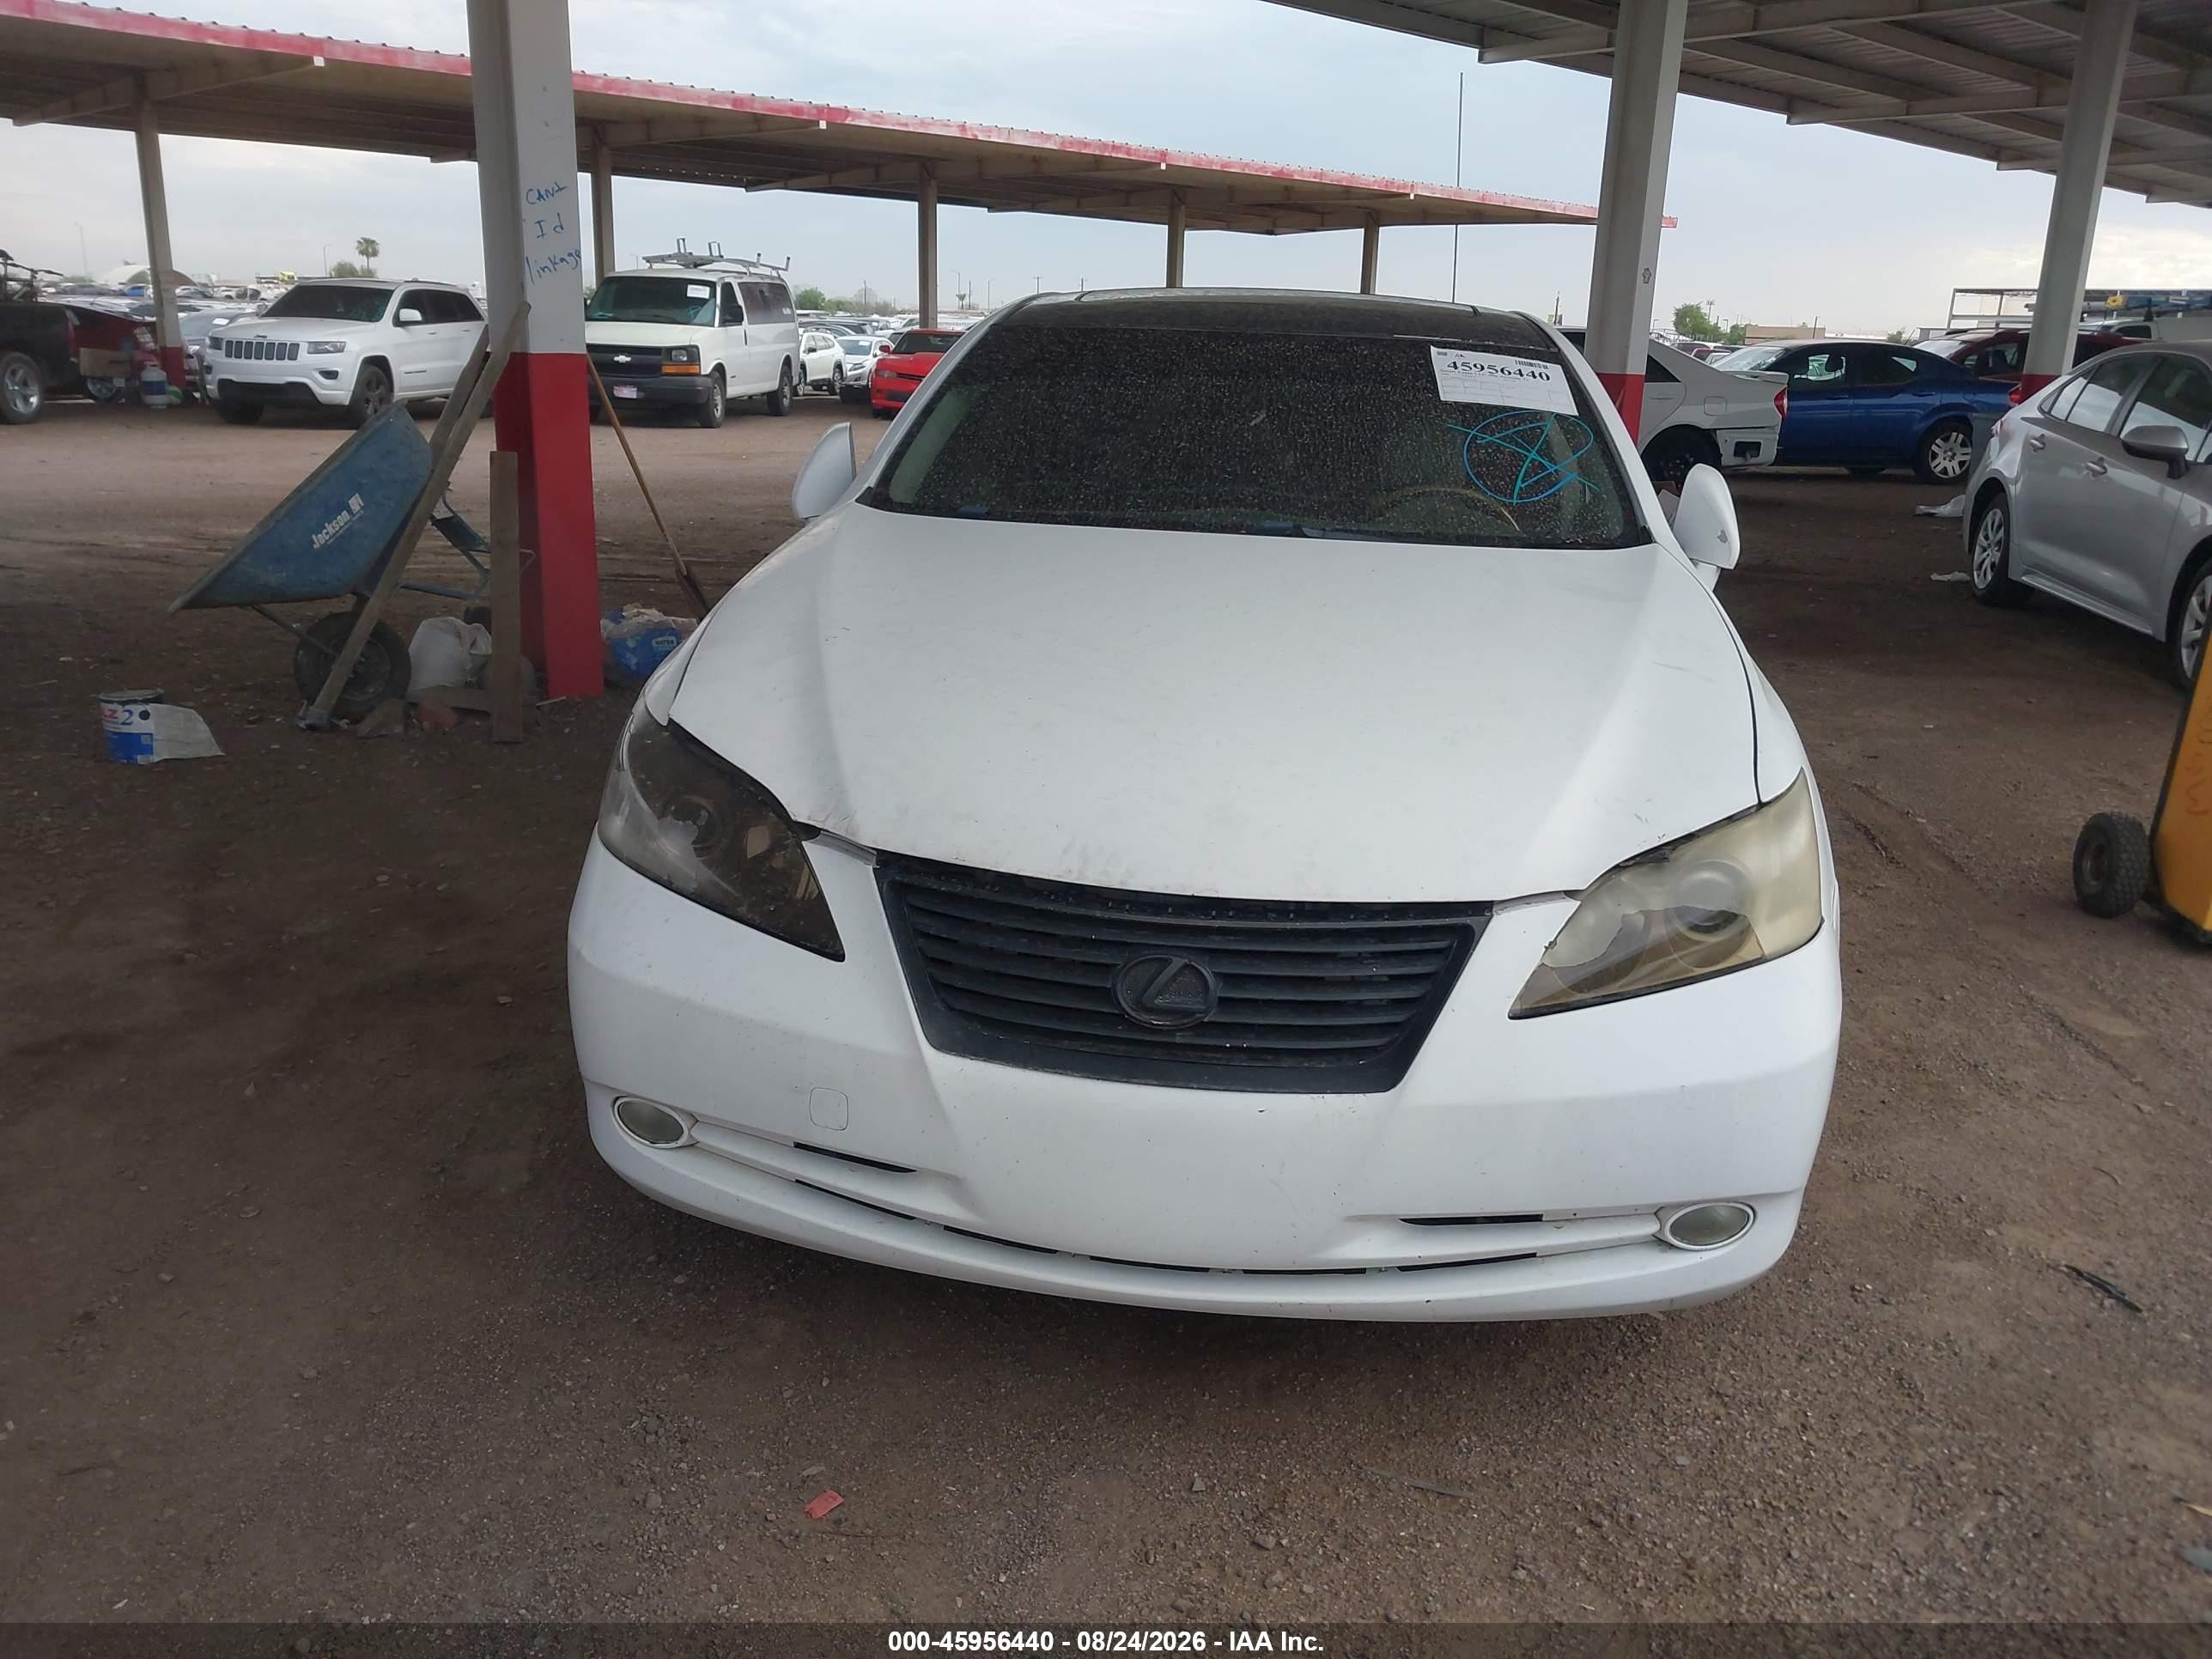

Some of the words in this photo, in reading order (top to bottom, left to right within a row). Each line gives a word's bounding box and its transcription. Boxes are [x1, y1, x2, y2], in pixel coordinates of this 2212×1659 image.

[1447, 360, 1551, 382] 45956440
[312, 510, 350, 549] Jackson
[120, 709, 134, 726] 2
